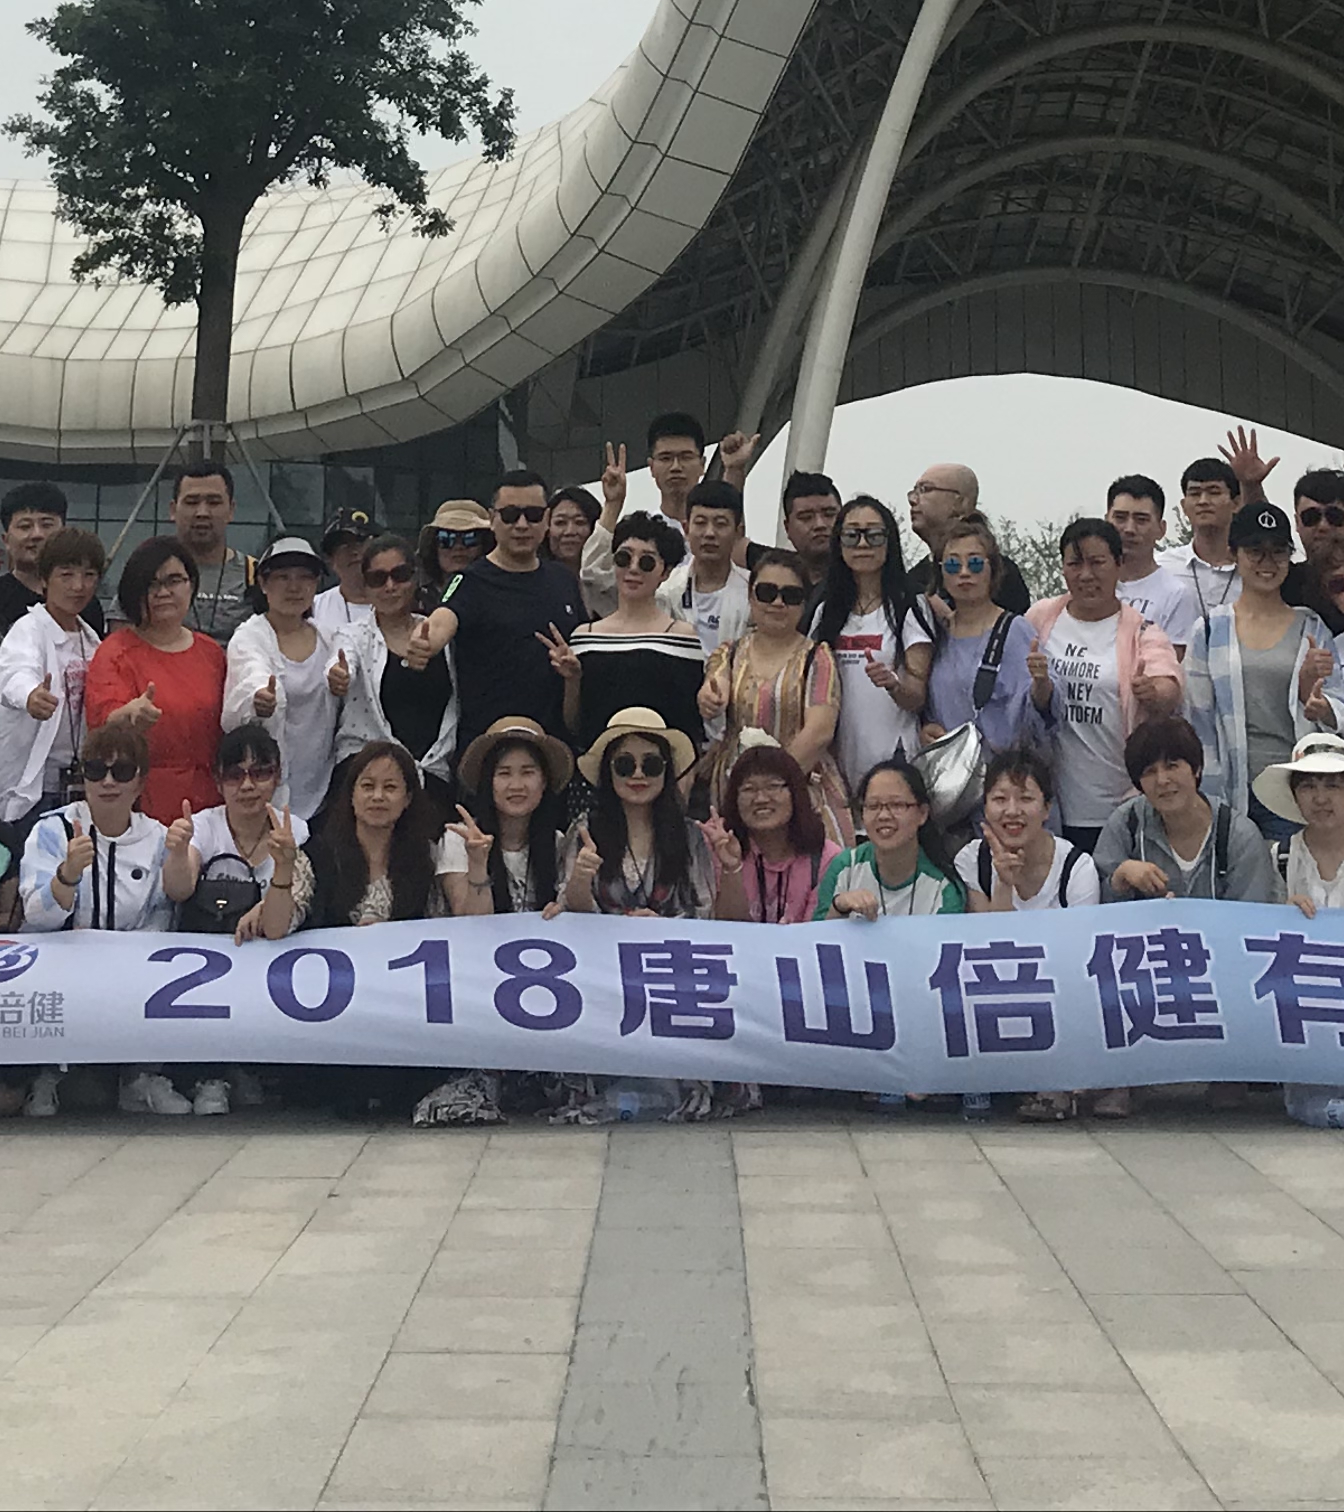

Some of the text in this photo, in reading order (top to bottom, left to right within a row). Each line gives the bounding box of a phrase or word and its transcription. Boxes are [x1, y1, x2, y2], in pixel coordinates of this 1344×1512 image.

[1051, 658, 1101, 680] ENMORE
[2, 1026, 27, 1038] BEI
[32, 1026, 65, 1038] JIAN
